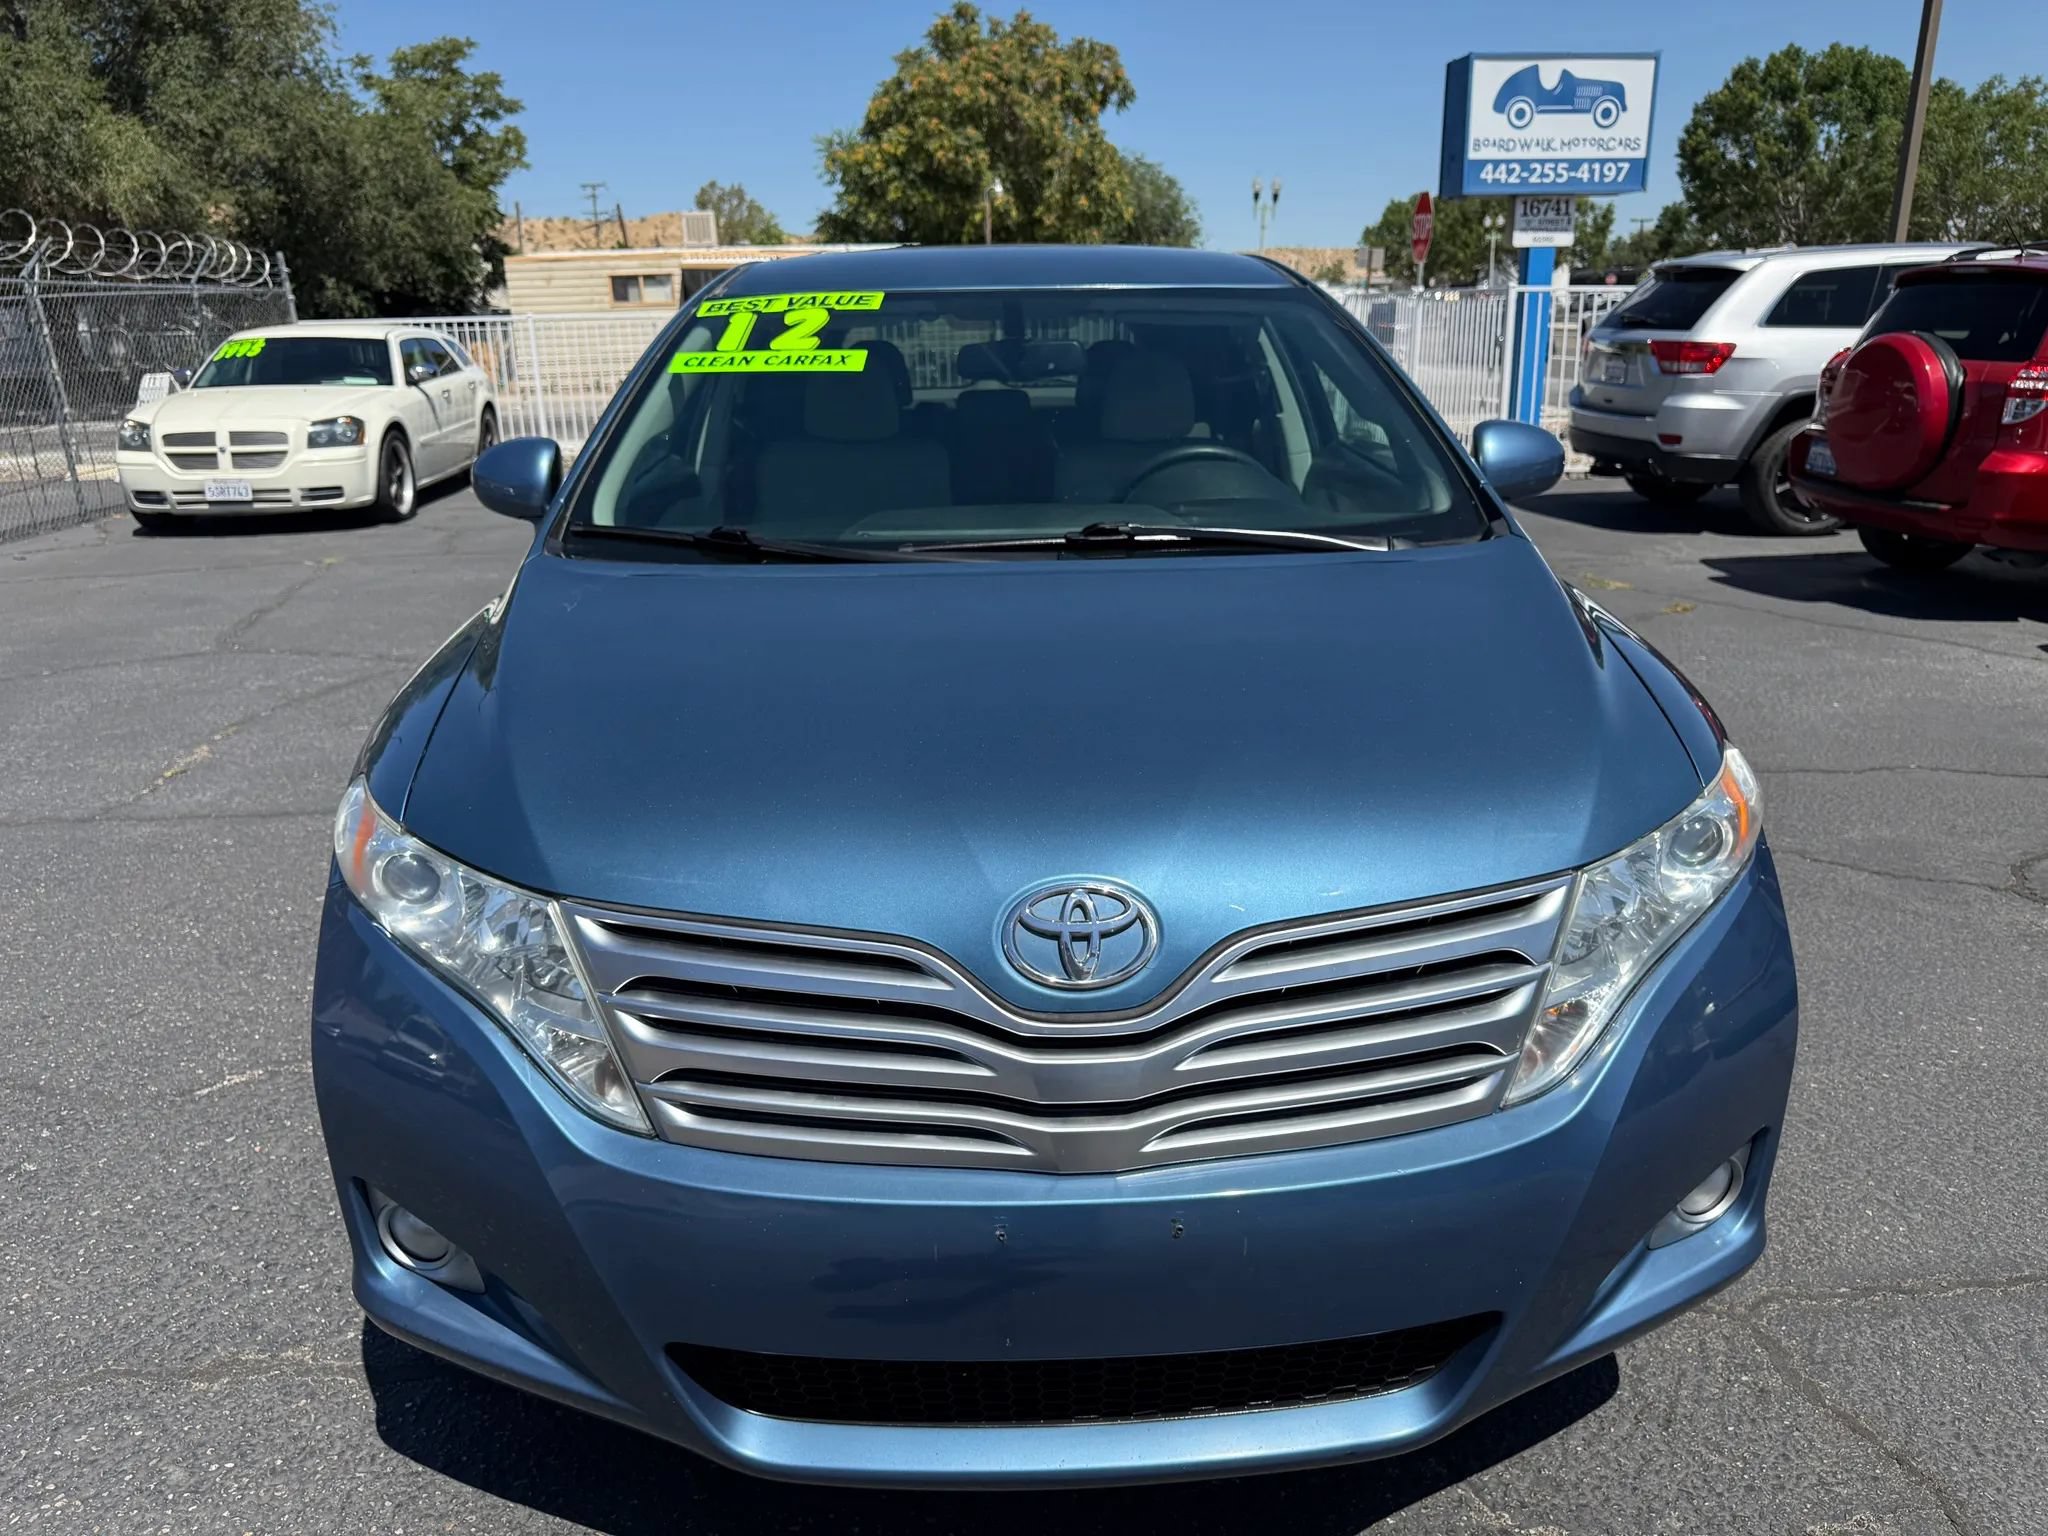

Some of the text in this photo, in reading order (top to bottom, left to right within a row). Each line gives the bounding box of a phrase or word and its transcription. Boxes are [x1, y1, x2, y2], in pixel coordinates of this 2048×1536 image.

[1559, 136, 1642, 153] MOTORCARS
[1480, 161, 1631, 184] 442-255-4197
[1520, 197, 1571, 217] 16741
[1412, 213, 1432, 241] STOP
[705, 294, 876, 314] BEST VALUE
[716, 307, 831, 352] 12
[683, 354, 852, 368] CLEAN CARFAX
